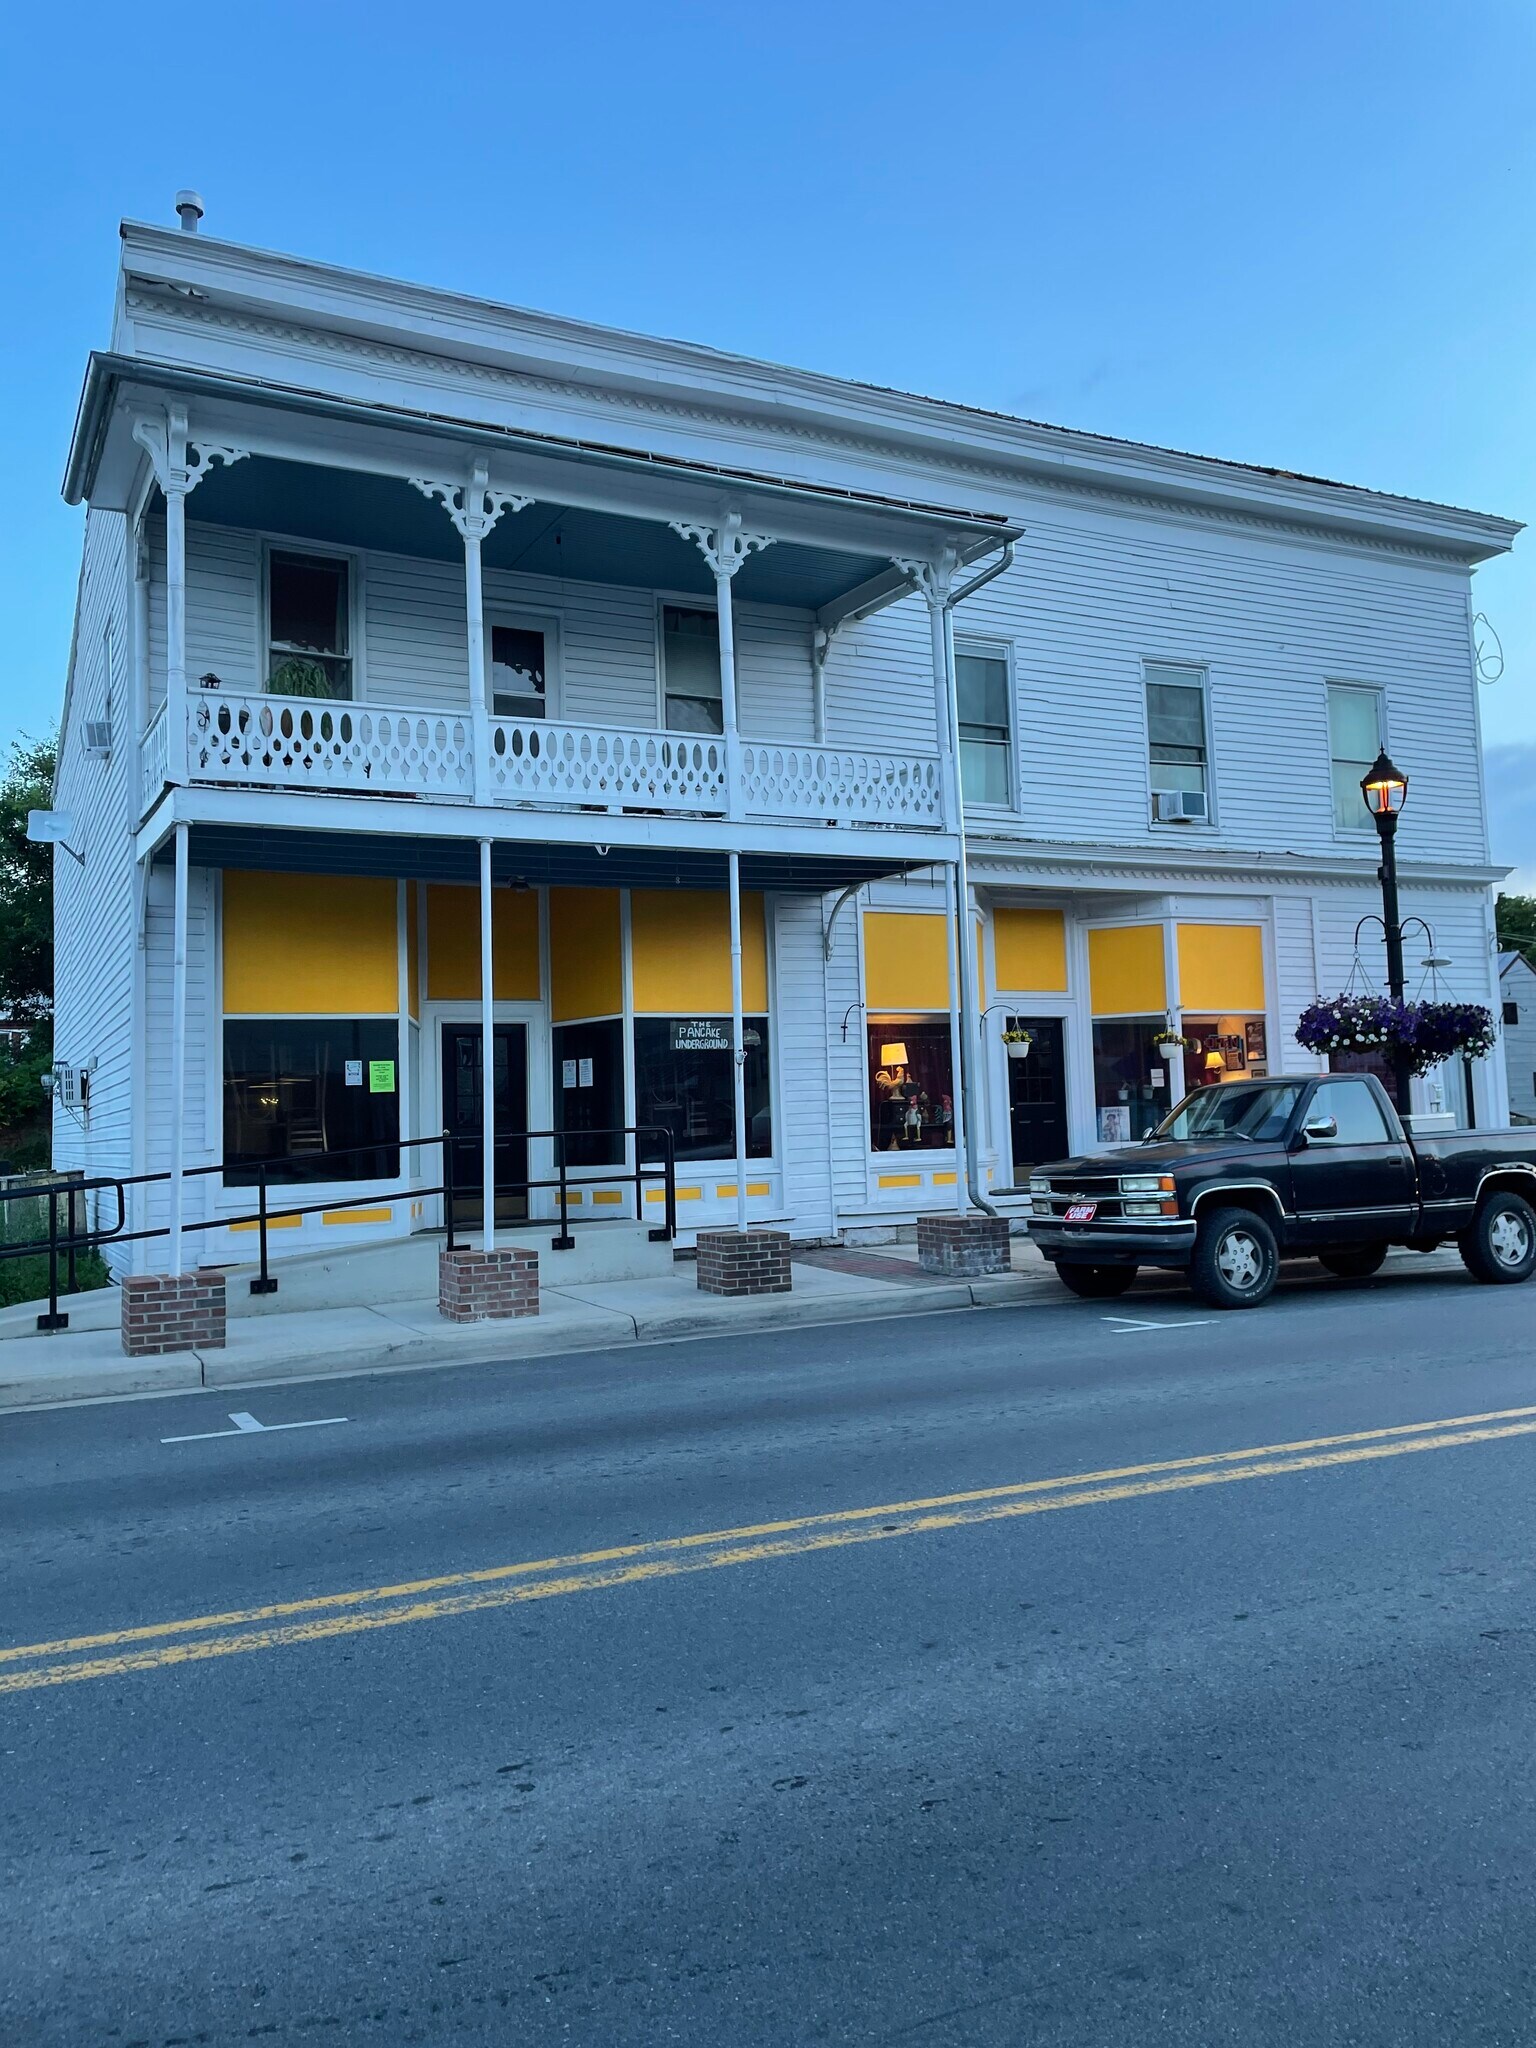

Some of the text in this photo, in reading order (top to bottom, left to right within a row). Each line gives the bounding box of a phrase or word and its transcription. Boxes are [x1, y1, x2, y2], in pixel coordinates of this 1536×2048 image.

[679, 1027, 721, 1038] PANCAKE
[675, 1038, 729, 1050] UNDERGROUND
[1069, 1206, 1095, 1214] FARM
